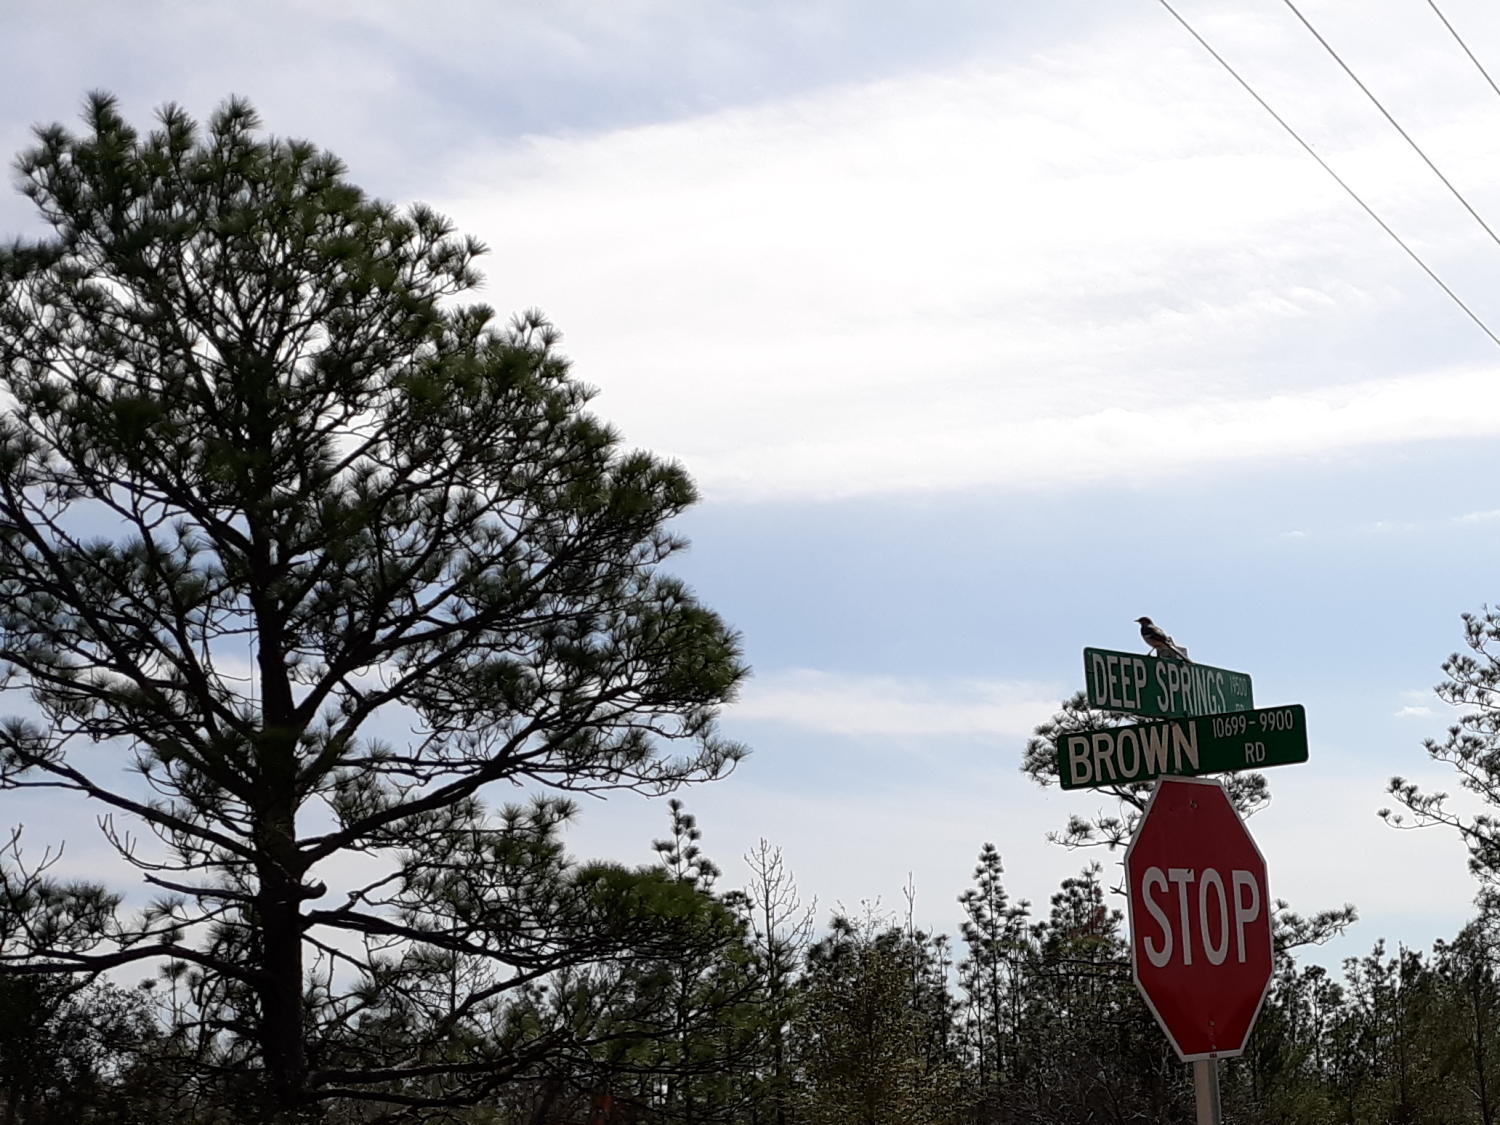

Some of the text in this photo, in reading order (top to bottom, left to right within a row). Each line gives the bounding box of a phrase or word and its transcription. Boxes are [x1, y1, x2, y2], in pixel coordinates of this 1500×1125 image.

[1092, 653, 1226, 715] DEEP SPRINGS
[1067, 720, 1200, 785] BROWN
[1244, 741, 1266, 764] RD
[1141, 866, 1260, 968] STOP
